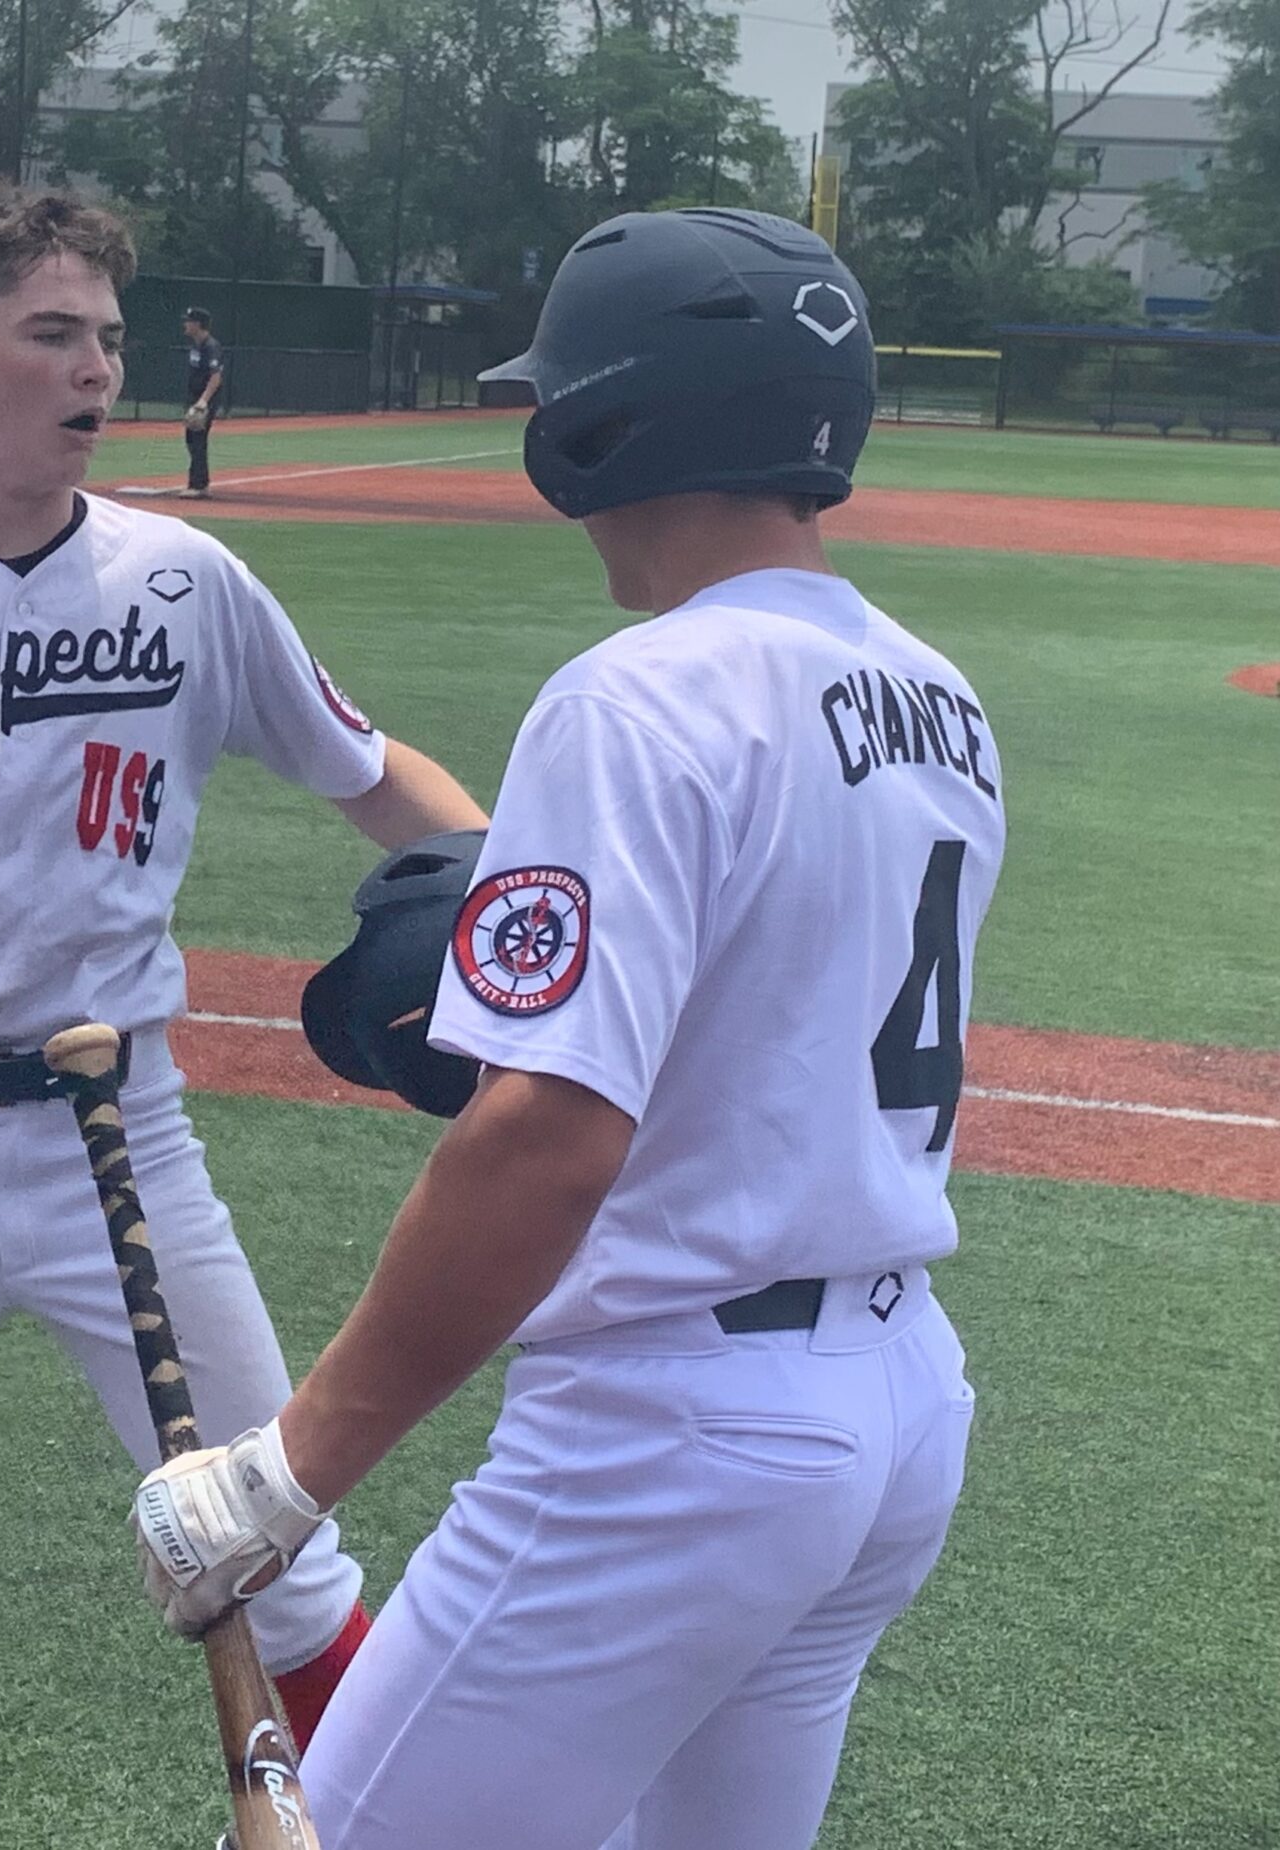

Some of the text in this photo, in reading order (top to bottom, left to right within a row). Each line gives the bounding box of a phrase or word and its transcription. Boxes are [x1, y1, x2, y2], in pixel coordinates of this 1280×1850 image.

[813, 421, 832, 457] 4
[821, 669, 997, 800] CHANCE
[870, 840, 966, 1152] 4
